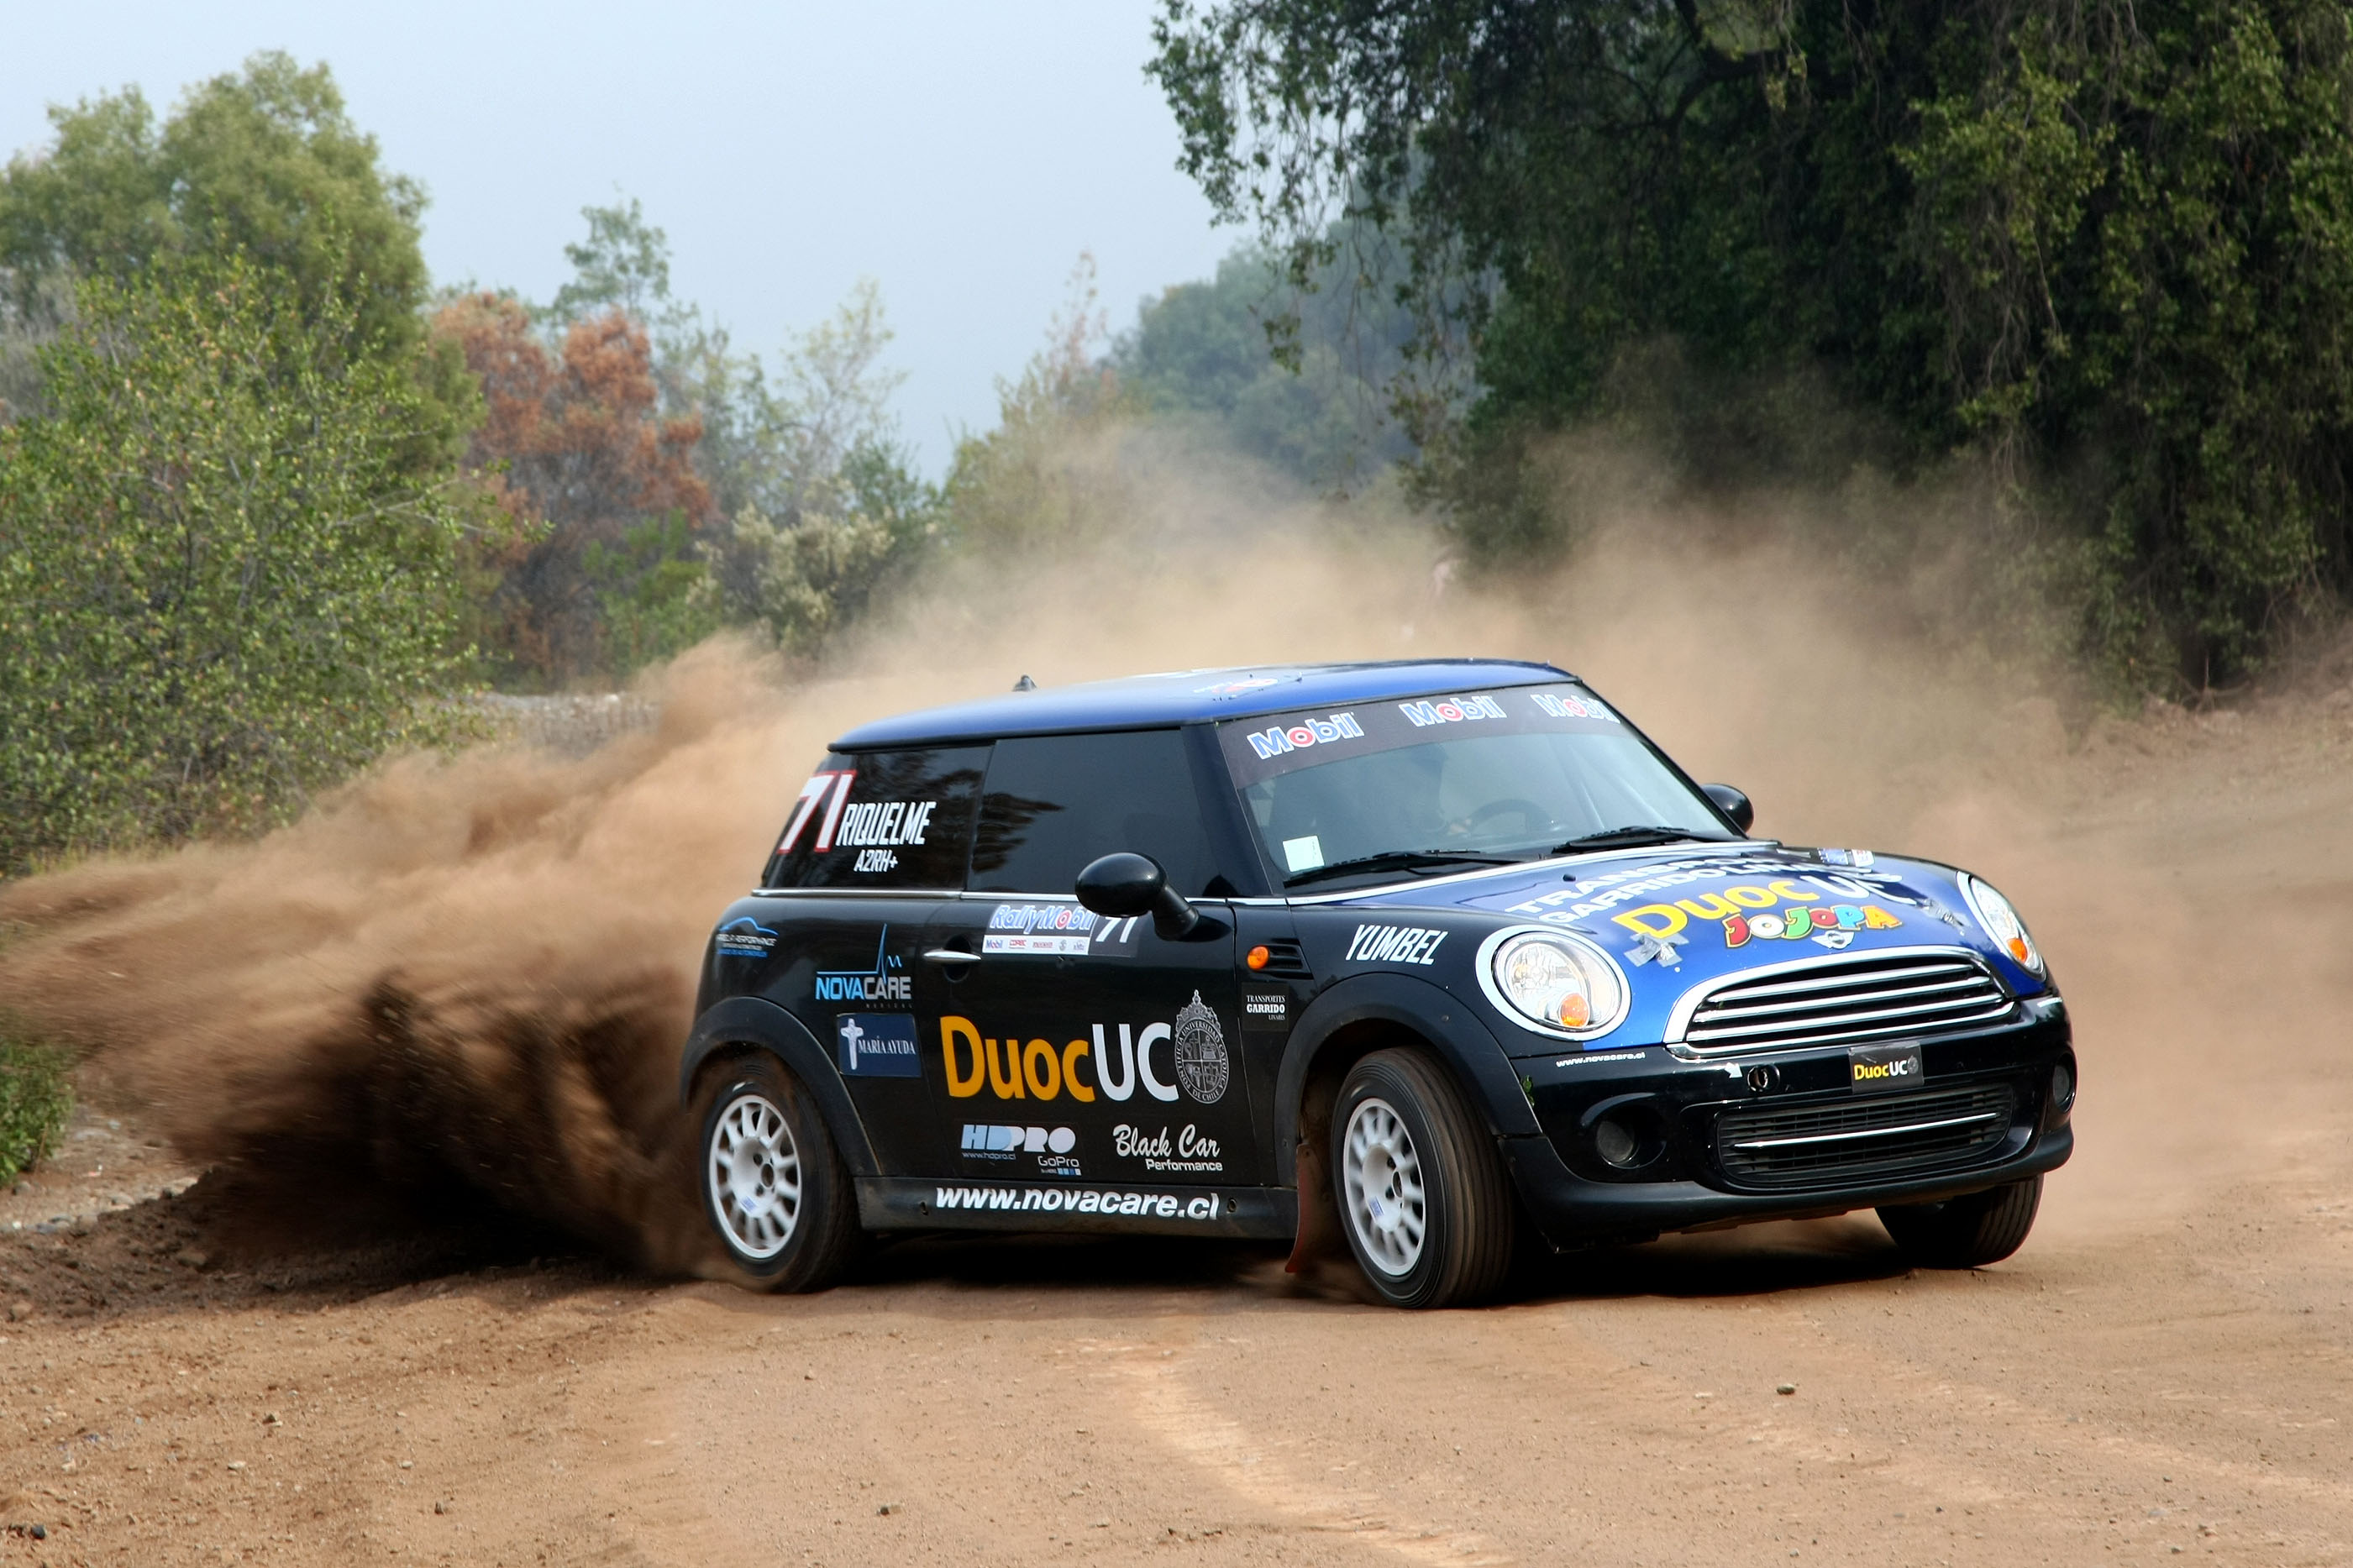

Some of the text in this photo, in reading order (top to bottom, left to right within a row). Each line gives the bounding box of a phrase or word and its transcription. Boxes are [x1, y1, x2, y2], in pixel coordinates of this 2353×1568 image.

[1399, 695, 1507, 727] Mobil
[1530, 694, 1620, 724] Mobil
[1247, 712, 1365, 760] Mobil
[776, 768, 857, 854] 71
[835, 801, 937, 846] RIQUELME
[853, 849, 899, 873] A2RH+
[1538, 868, 1727, 923] GARRIDO
[1095, 916, 1138, 943] 71
[1345, 924, 1449, 965] YUMBEL
[816, 976, 912, 1000] NOVACARE
[1246, 994, 1285, 1003] TRANSPORTES
[1246, 1004, 1285, 1014] GARRIDO
[887, 1039, 917, 1055] AYUDA
[1113, 1124, 1221, 1158] Black Car
[1037, 1156, 1080, 1167] GoPro
[1145, 1158, 1223, 1172] Performance
[936, 1187, 1220, 1220] www.novacare.cl
